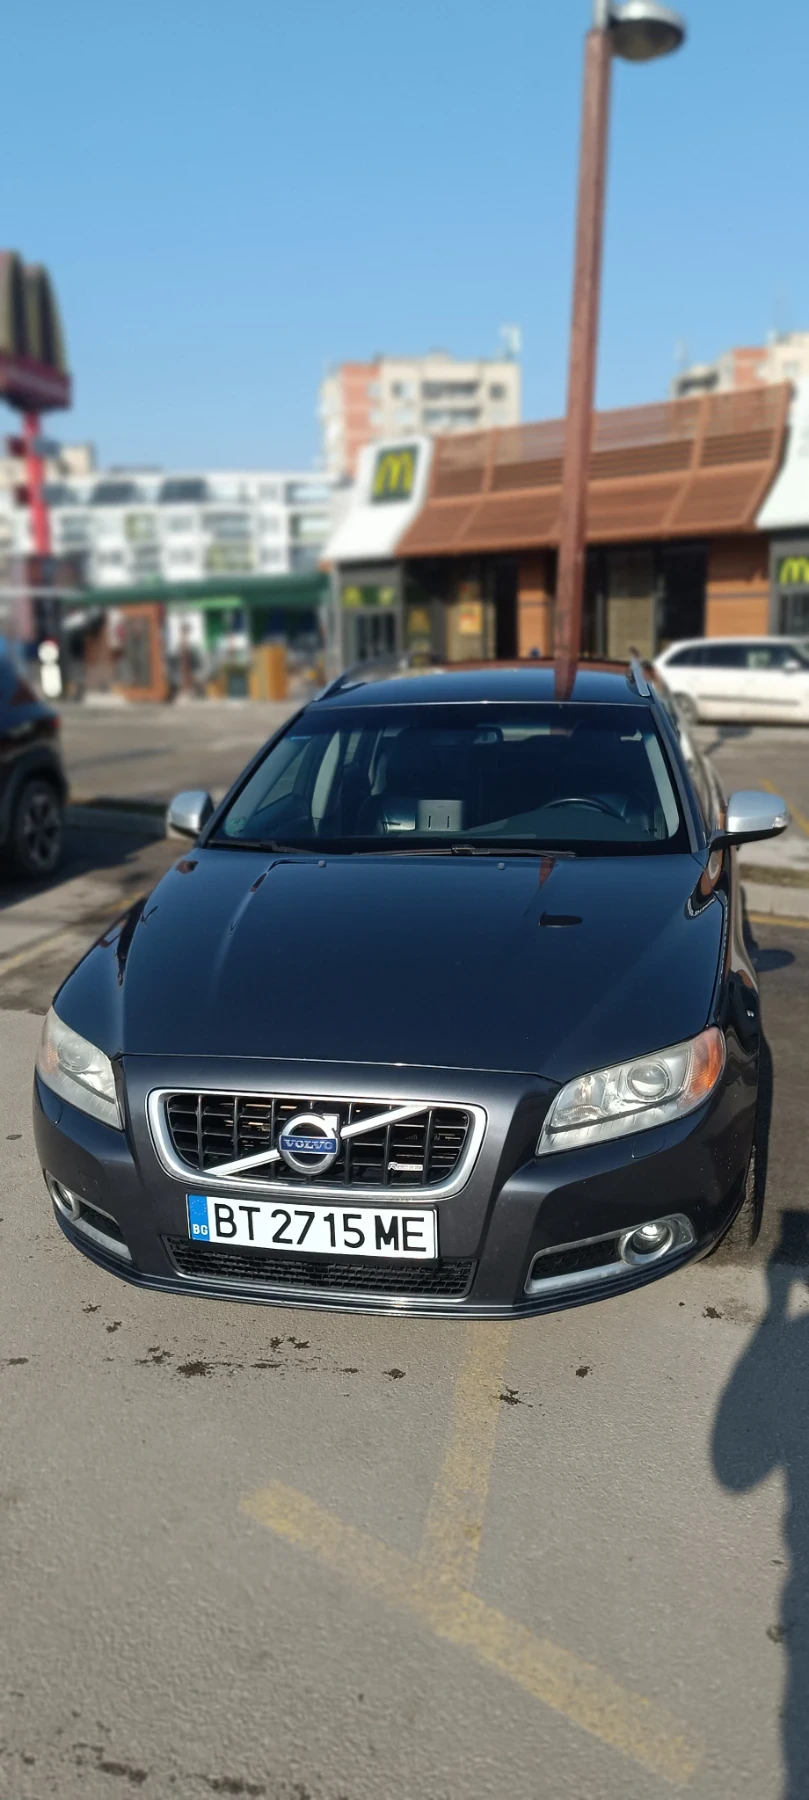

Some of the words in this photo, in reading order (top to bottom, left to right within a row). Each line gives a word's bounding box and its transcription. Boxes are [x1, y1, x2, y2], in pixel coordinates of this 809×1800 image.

[283, 1139, 333, 1150] VOLVO
[192, 1224, 208, 1236] BG
[214, 1203, 261, 1241] BT
[271, 1208, 365, 1248] 2715
[374, 1215, 427, 1252] ME
